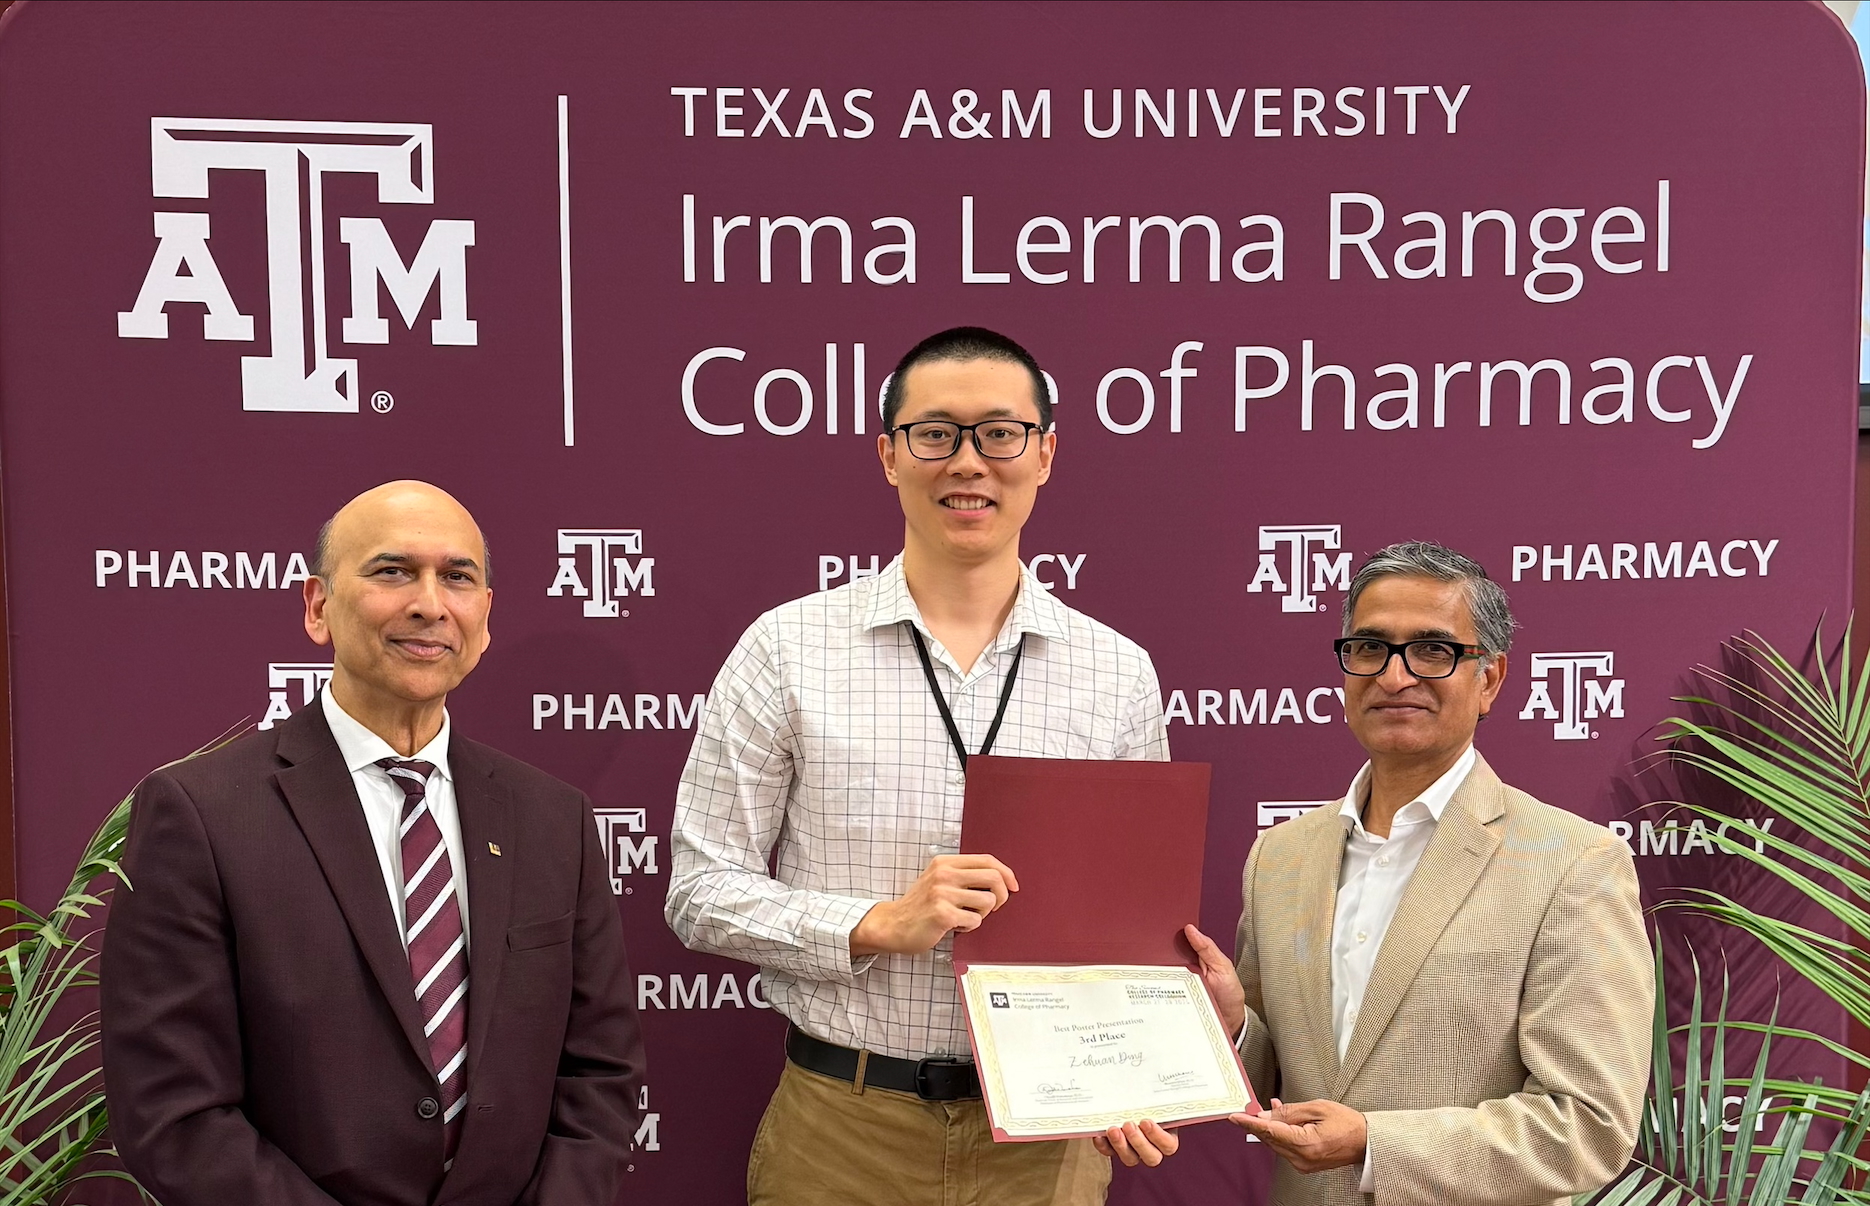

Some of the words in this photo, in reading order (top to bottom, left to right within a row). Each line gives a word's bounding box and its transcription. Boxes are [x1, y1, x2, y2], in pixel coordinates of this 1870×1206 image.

[670, 86, 875, 139] TEXAS
[899, 88, 1052, 139] A&M
[1083, 84, 1471, 139] UNIVERSITY
[682, 194, 917, 285] Irma
[962, 195, 1285, 285] Lerma
[1329, 179, 1671, 304] Rangel
[681, 342, 1059, 436] Coll
[1095, 340, 1204, 435] of
[1234, 339, 1754, 449] Pharmacy
[95, 549, 312, 590] PHARMA
[1512, 539, 1780, 582] PHARMACY
[532, 693, 706, 731] PHARM
[1164, 686, 1348, 726] ARMAC
[637, 972, 773, 1010] RMAC
[1079, 1034, 1097, 1045] 3rd
[1099, 1032, 1126, 1042] Place
[1096, 1018, 1144, 1029] Presentation
